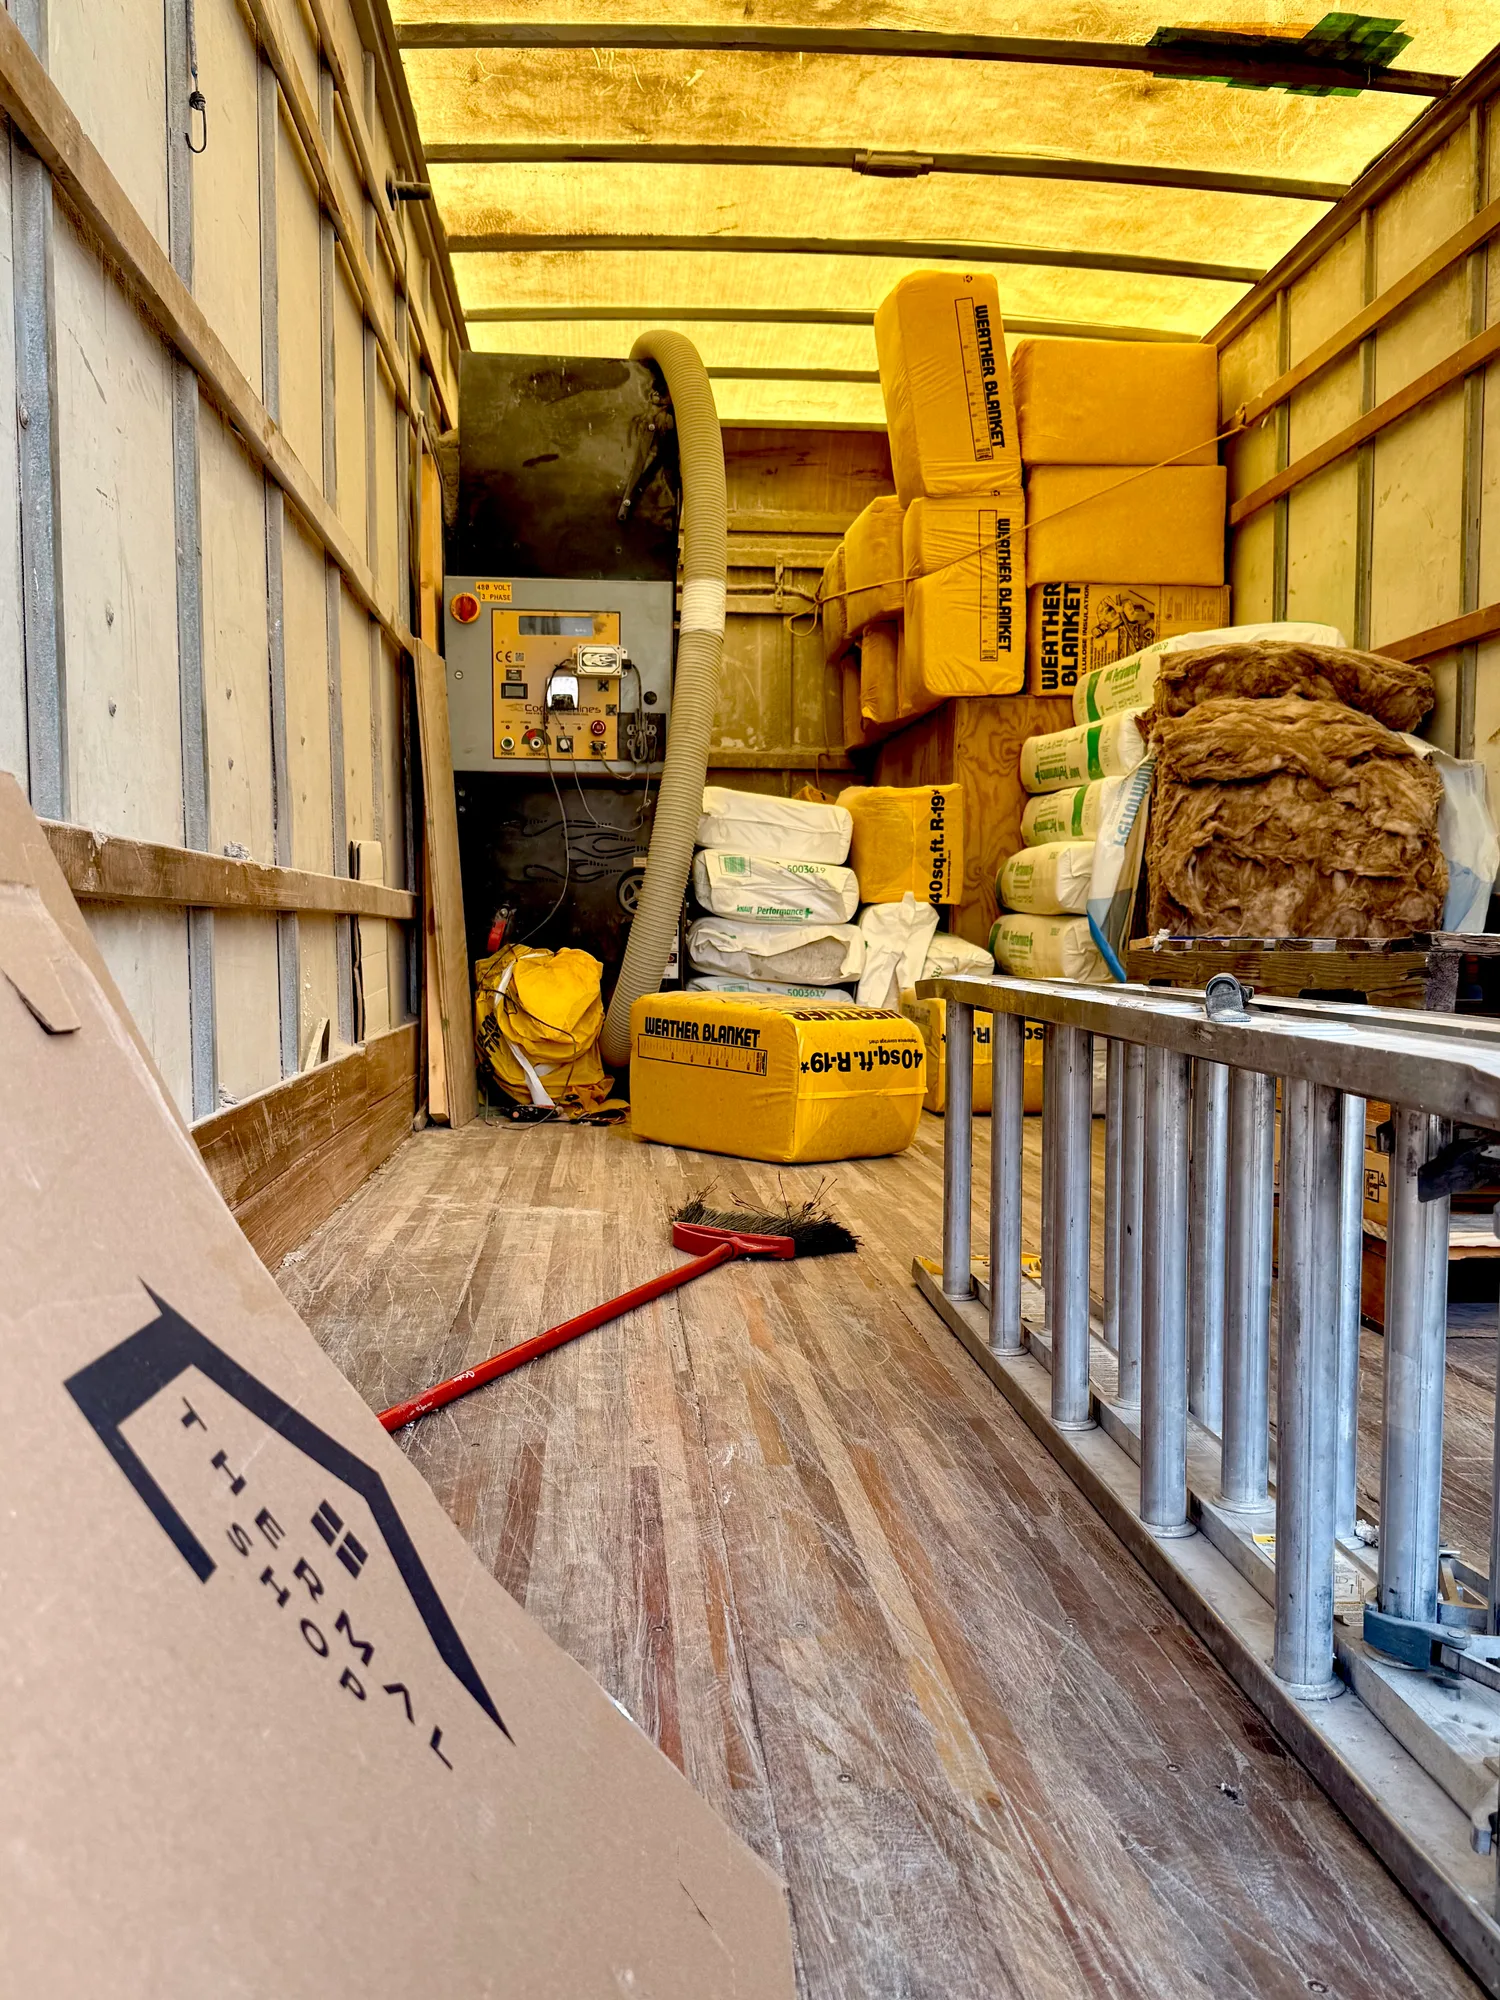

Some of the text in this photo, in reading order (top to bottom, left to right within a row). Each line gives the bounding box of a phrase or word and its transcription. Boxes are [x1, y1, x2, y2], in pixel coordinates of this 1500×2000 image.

[974, 304, 1006, 449] WEATHER BLANKET
[997, 518, 1012, 653] WEATHER BLANKET
[1041, 582, 1061, 690] WEATHER
[1061, 584, 1081, 687] BLANKET
[1082, 584, 1090, 637] INSULATION
[787, 864, 826, 874] 5003619
[644, 1016, 760, 1048] WEATHER BLANKET
[226, 1521, 368, 1701] SHOP
